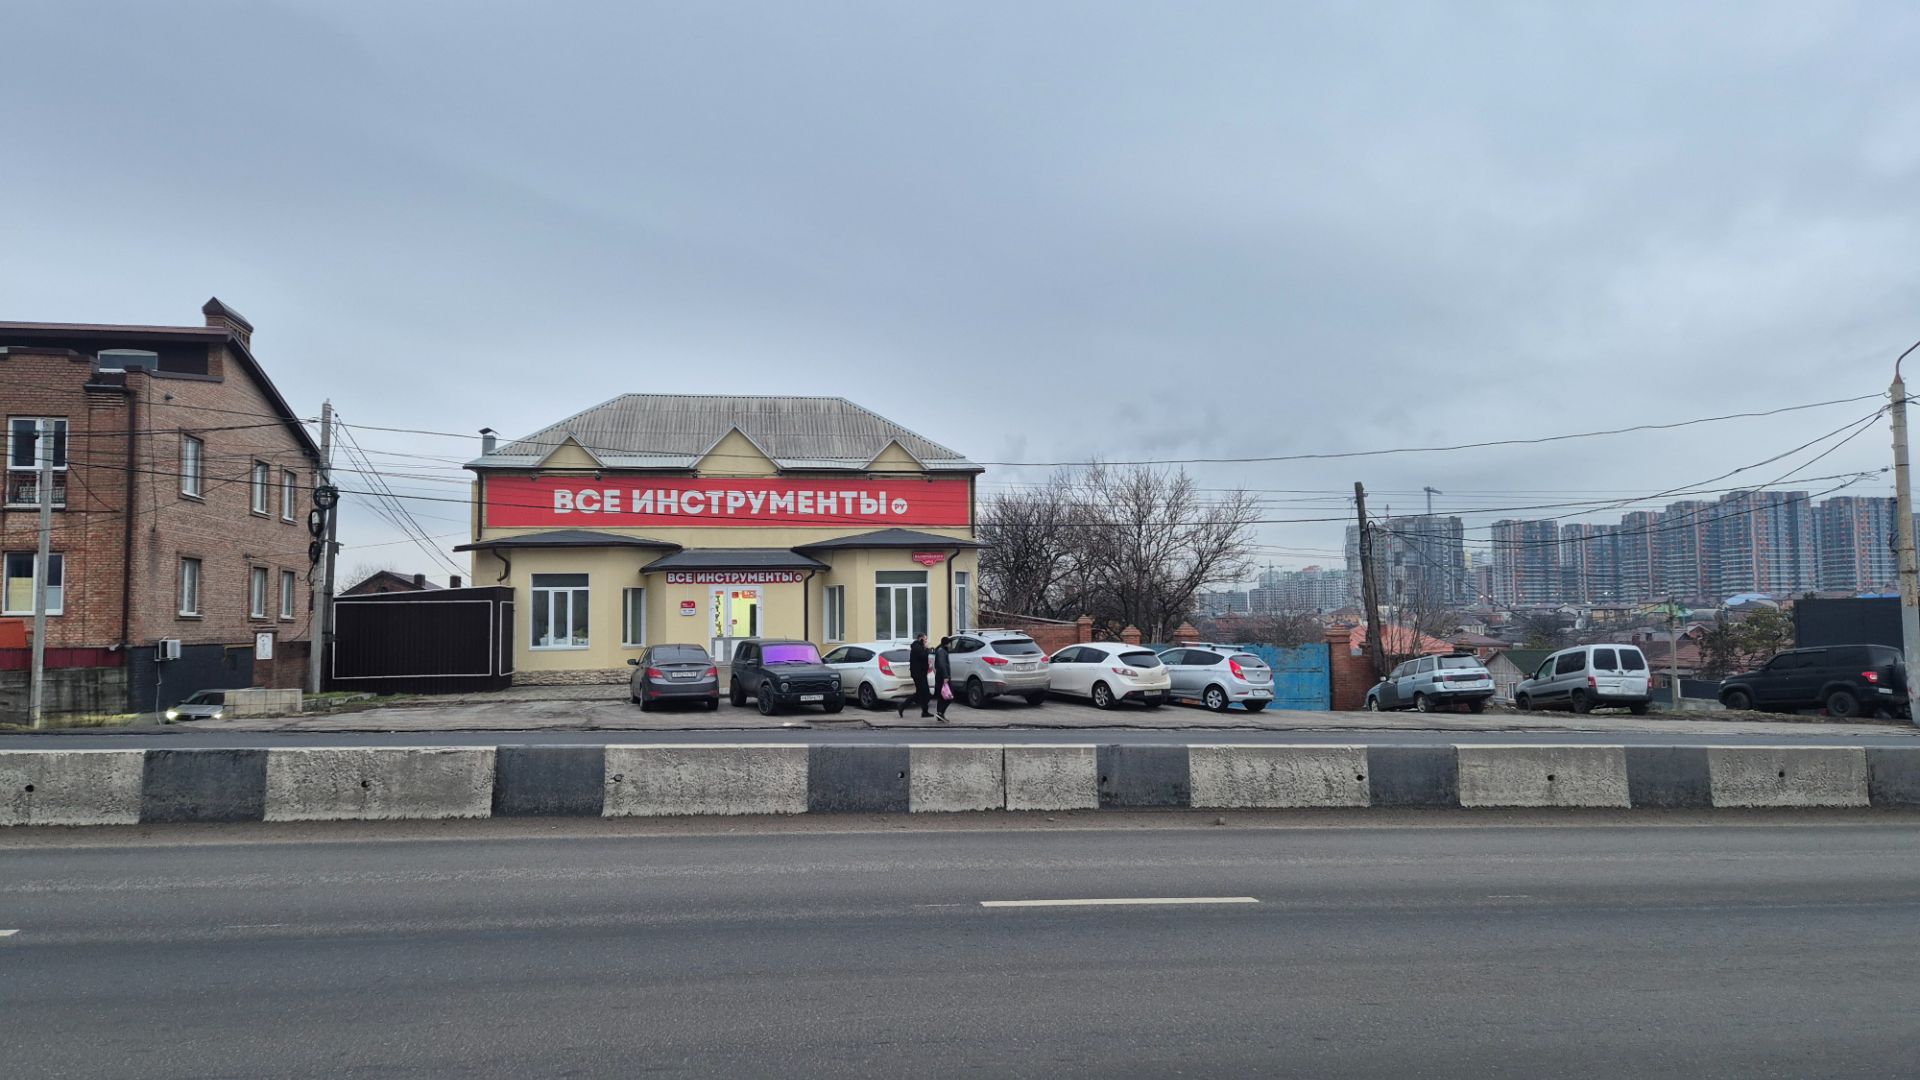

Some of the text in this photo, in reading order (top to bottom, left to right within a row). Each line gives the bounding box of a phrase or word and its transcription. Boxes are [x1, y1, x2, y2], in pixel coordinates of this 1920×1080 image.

[554, 489, 621, 514] ВСЕ
[632, 489, 887, 515] ИНСТРУМЕНТЫ
[667, 572, 693, 583] ВСЕ
[696, 572, 793, 583] ИНСТРУМЕНТЫ
